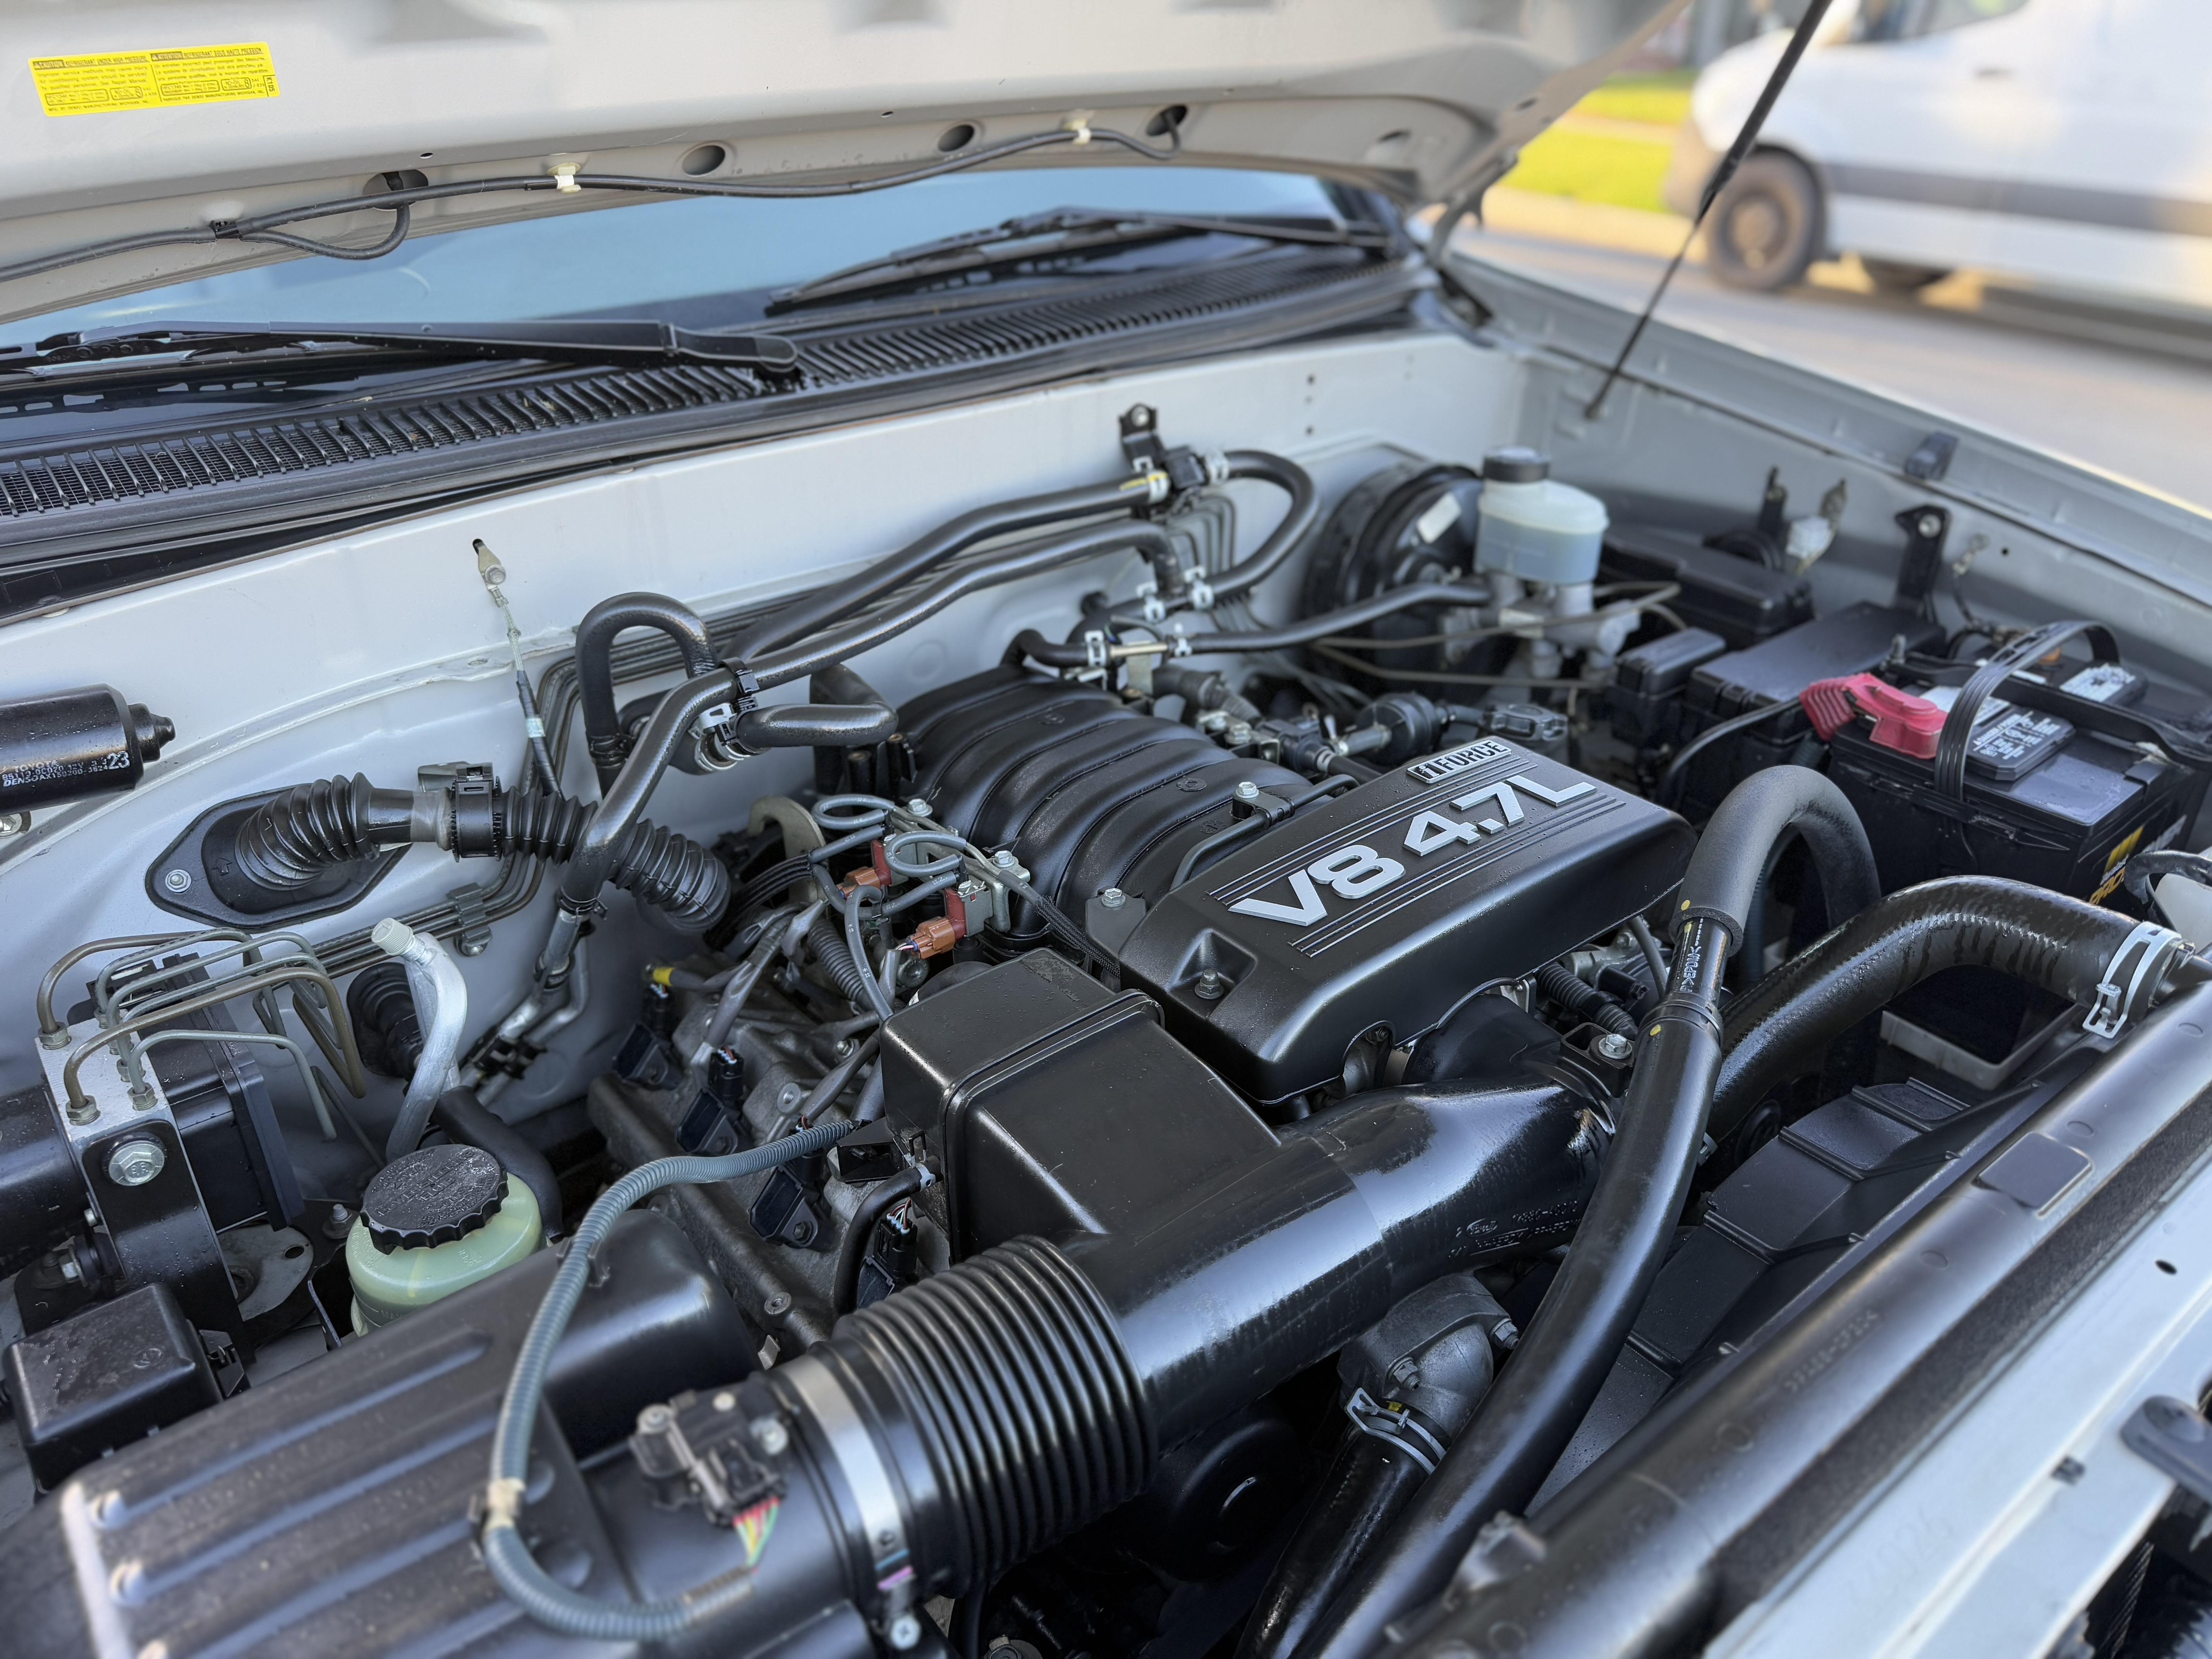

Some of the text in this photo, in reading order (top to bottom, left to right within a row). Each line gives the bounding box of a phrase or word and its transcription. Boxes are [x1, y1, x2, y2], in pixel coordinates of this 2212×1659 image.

[244, 79, 249, 88] 8
[266, 77, 275, 92] K105
[12, 759, 59, 773] TOYOTA
[107, 751, 130, 769] 23
[3, 775, 38, 787] DENSO
[1228, 775, 1597, 926] V8 4.7L
[374, 1189, 422, 1216] POWER
[420, 1150, 474, 1188] STEERING
[421, 1178, 455, 1200] FLUID
